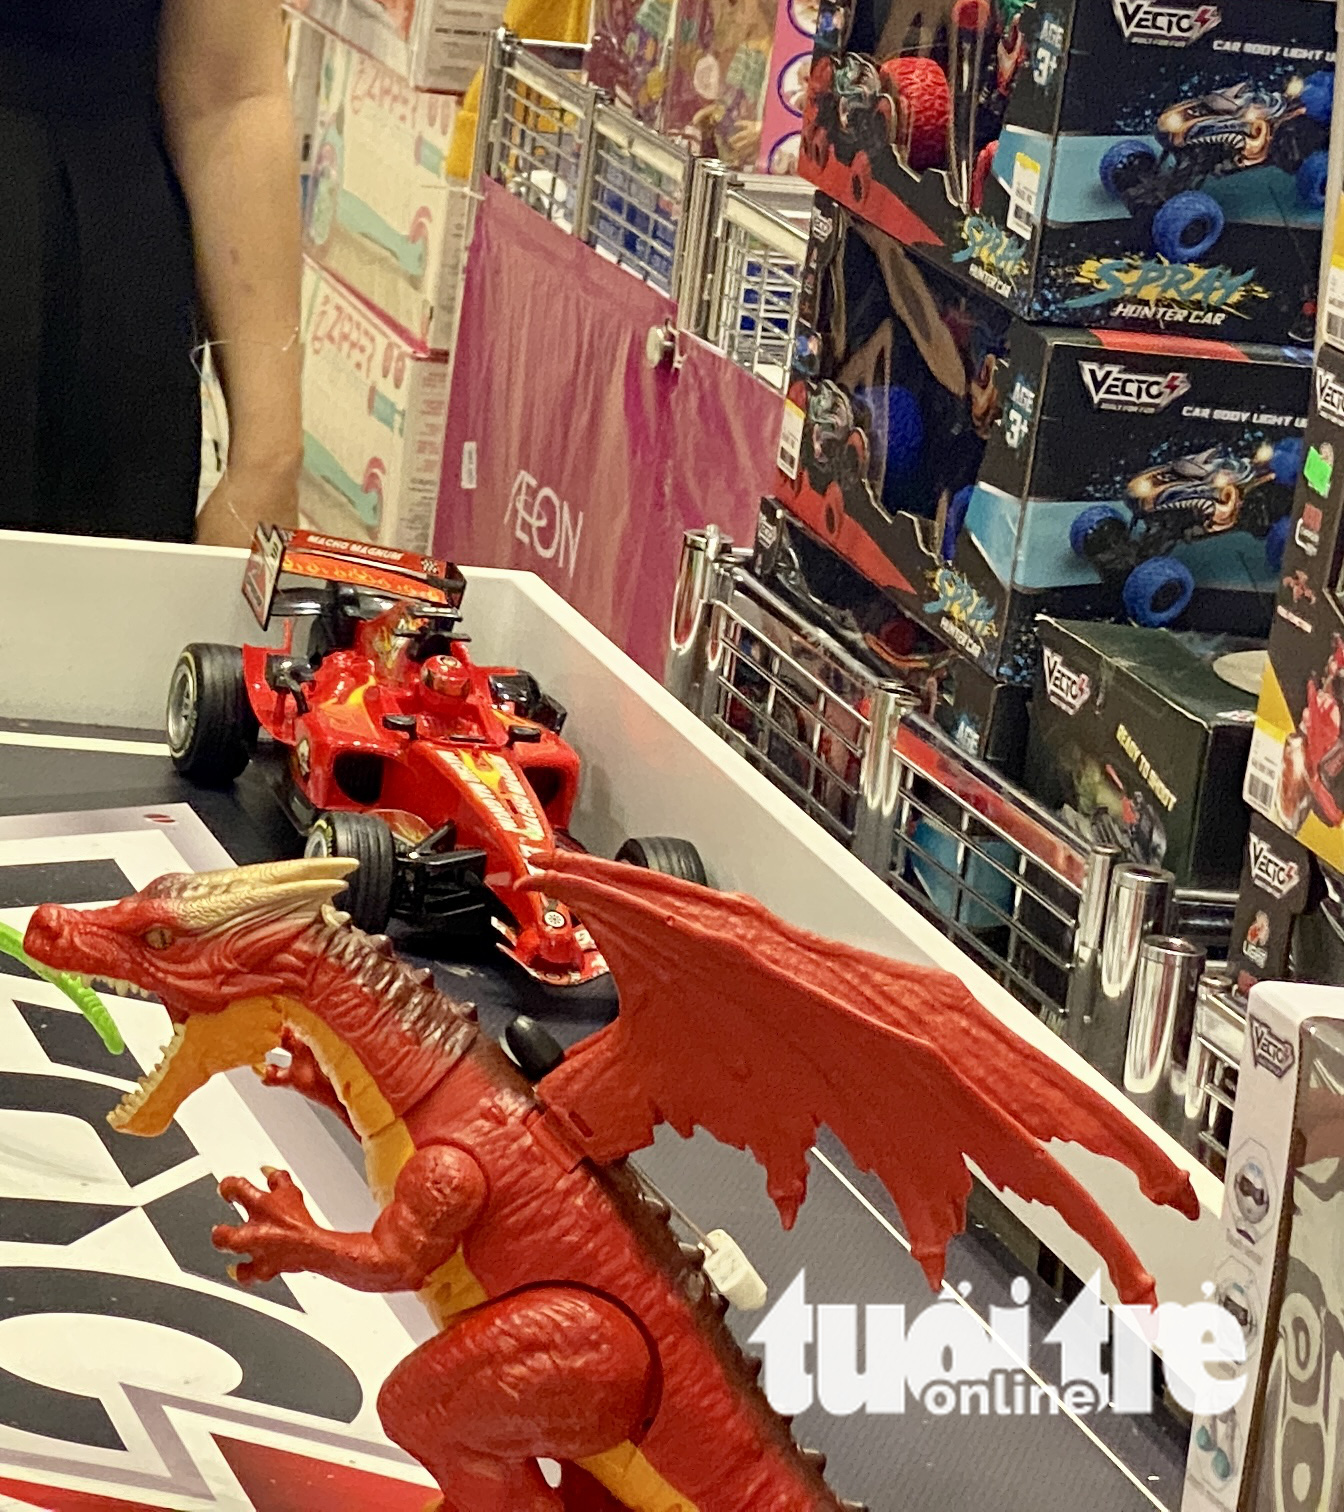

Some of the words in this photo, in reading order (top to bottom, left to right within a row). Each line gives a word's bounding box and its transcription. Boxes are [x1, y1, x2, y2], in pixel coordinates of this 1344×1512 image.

[1212, 40, 1241, 53] CAR
[1283, 47, 1324, 61] LIGHT
[1188, 311, 1227, 326] CAR
[1181, 406, 1210, 419] CAR
[1253, 413, 1293, 426] LIGHT
